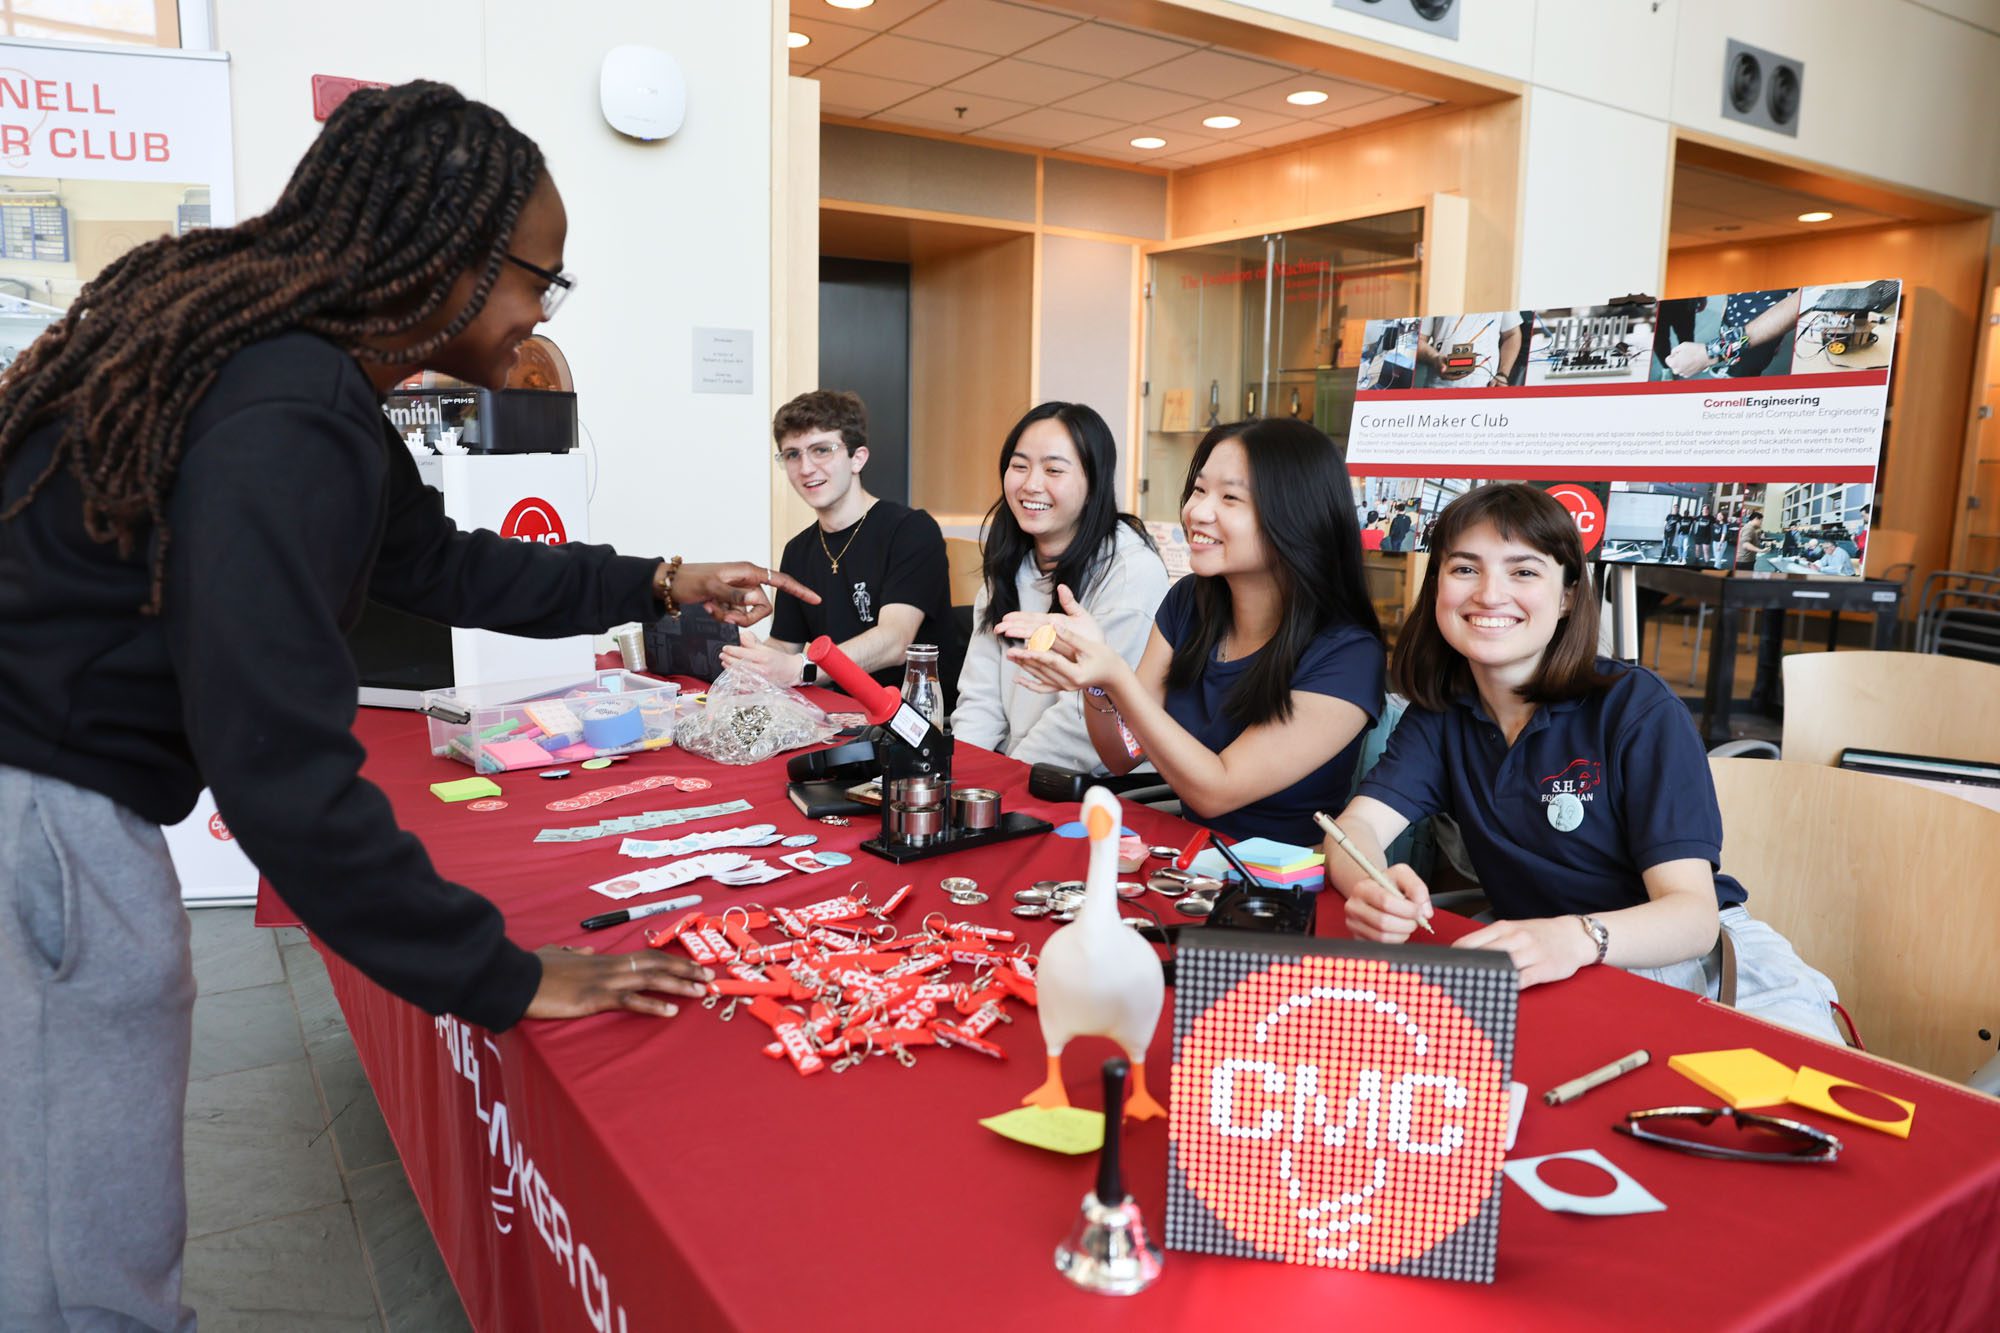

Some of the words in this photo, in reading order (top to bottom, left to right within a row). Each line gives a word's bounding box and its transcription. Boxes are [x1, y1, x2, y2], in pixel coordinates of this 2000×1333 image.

[50, 127, 170, 163] CLUB
[1360, 414, 1415, 428] Cornell
[1418, 413, 1466, 428] Maker
[1471, 412, 1509, 428] Club
[1702, 410, 1744, 421] Electrical
[1746, 409, 1763, 419] and
[1766, 408, 1816, 419] Computer
[1818, 406, 1880, 418] Engineering
[1552, 780, 1576, 793] S.H.
[1210, 1057, 1467, 1156] CMC
